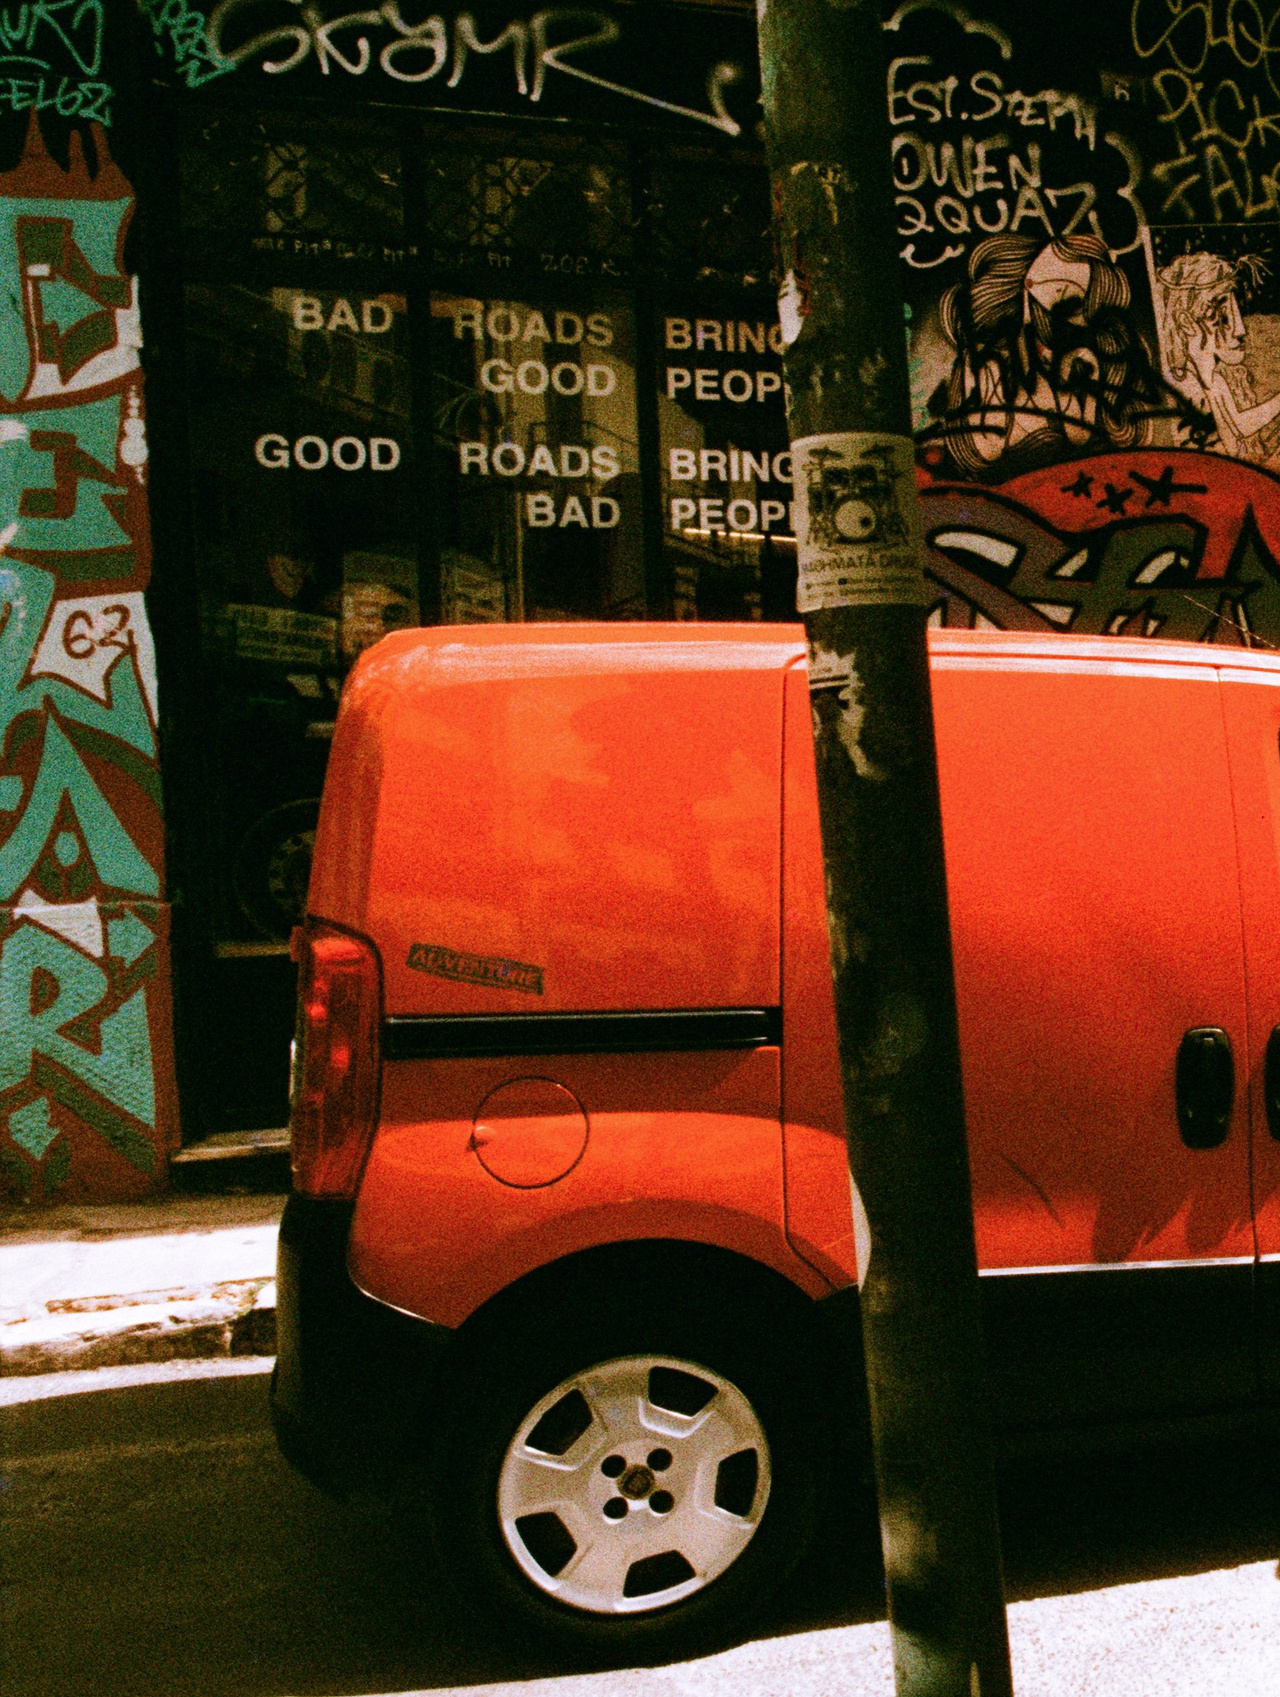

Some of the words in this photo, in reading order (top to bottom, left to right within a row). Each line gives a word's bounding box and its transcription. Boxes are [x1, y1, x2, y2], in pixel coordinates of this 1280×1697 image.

[293, 296, 394, 334] BAD
[453, 308, 615, 347] ROADS
[481, 359, 617, 398] GOOD
[666, 367, 782, 403] PEOP
[255, 434, 402, 472] GOOD
[459, 442, 621, 480] ROADS
[669, 448, 793, 484] BRING
[527, 494, 621, 529] BAD
[671, 498, 794, 531] PEOP
